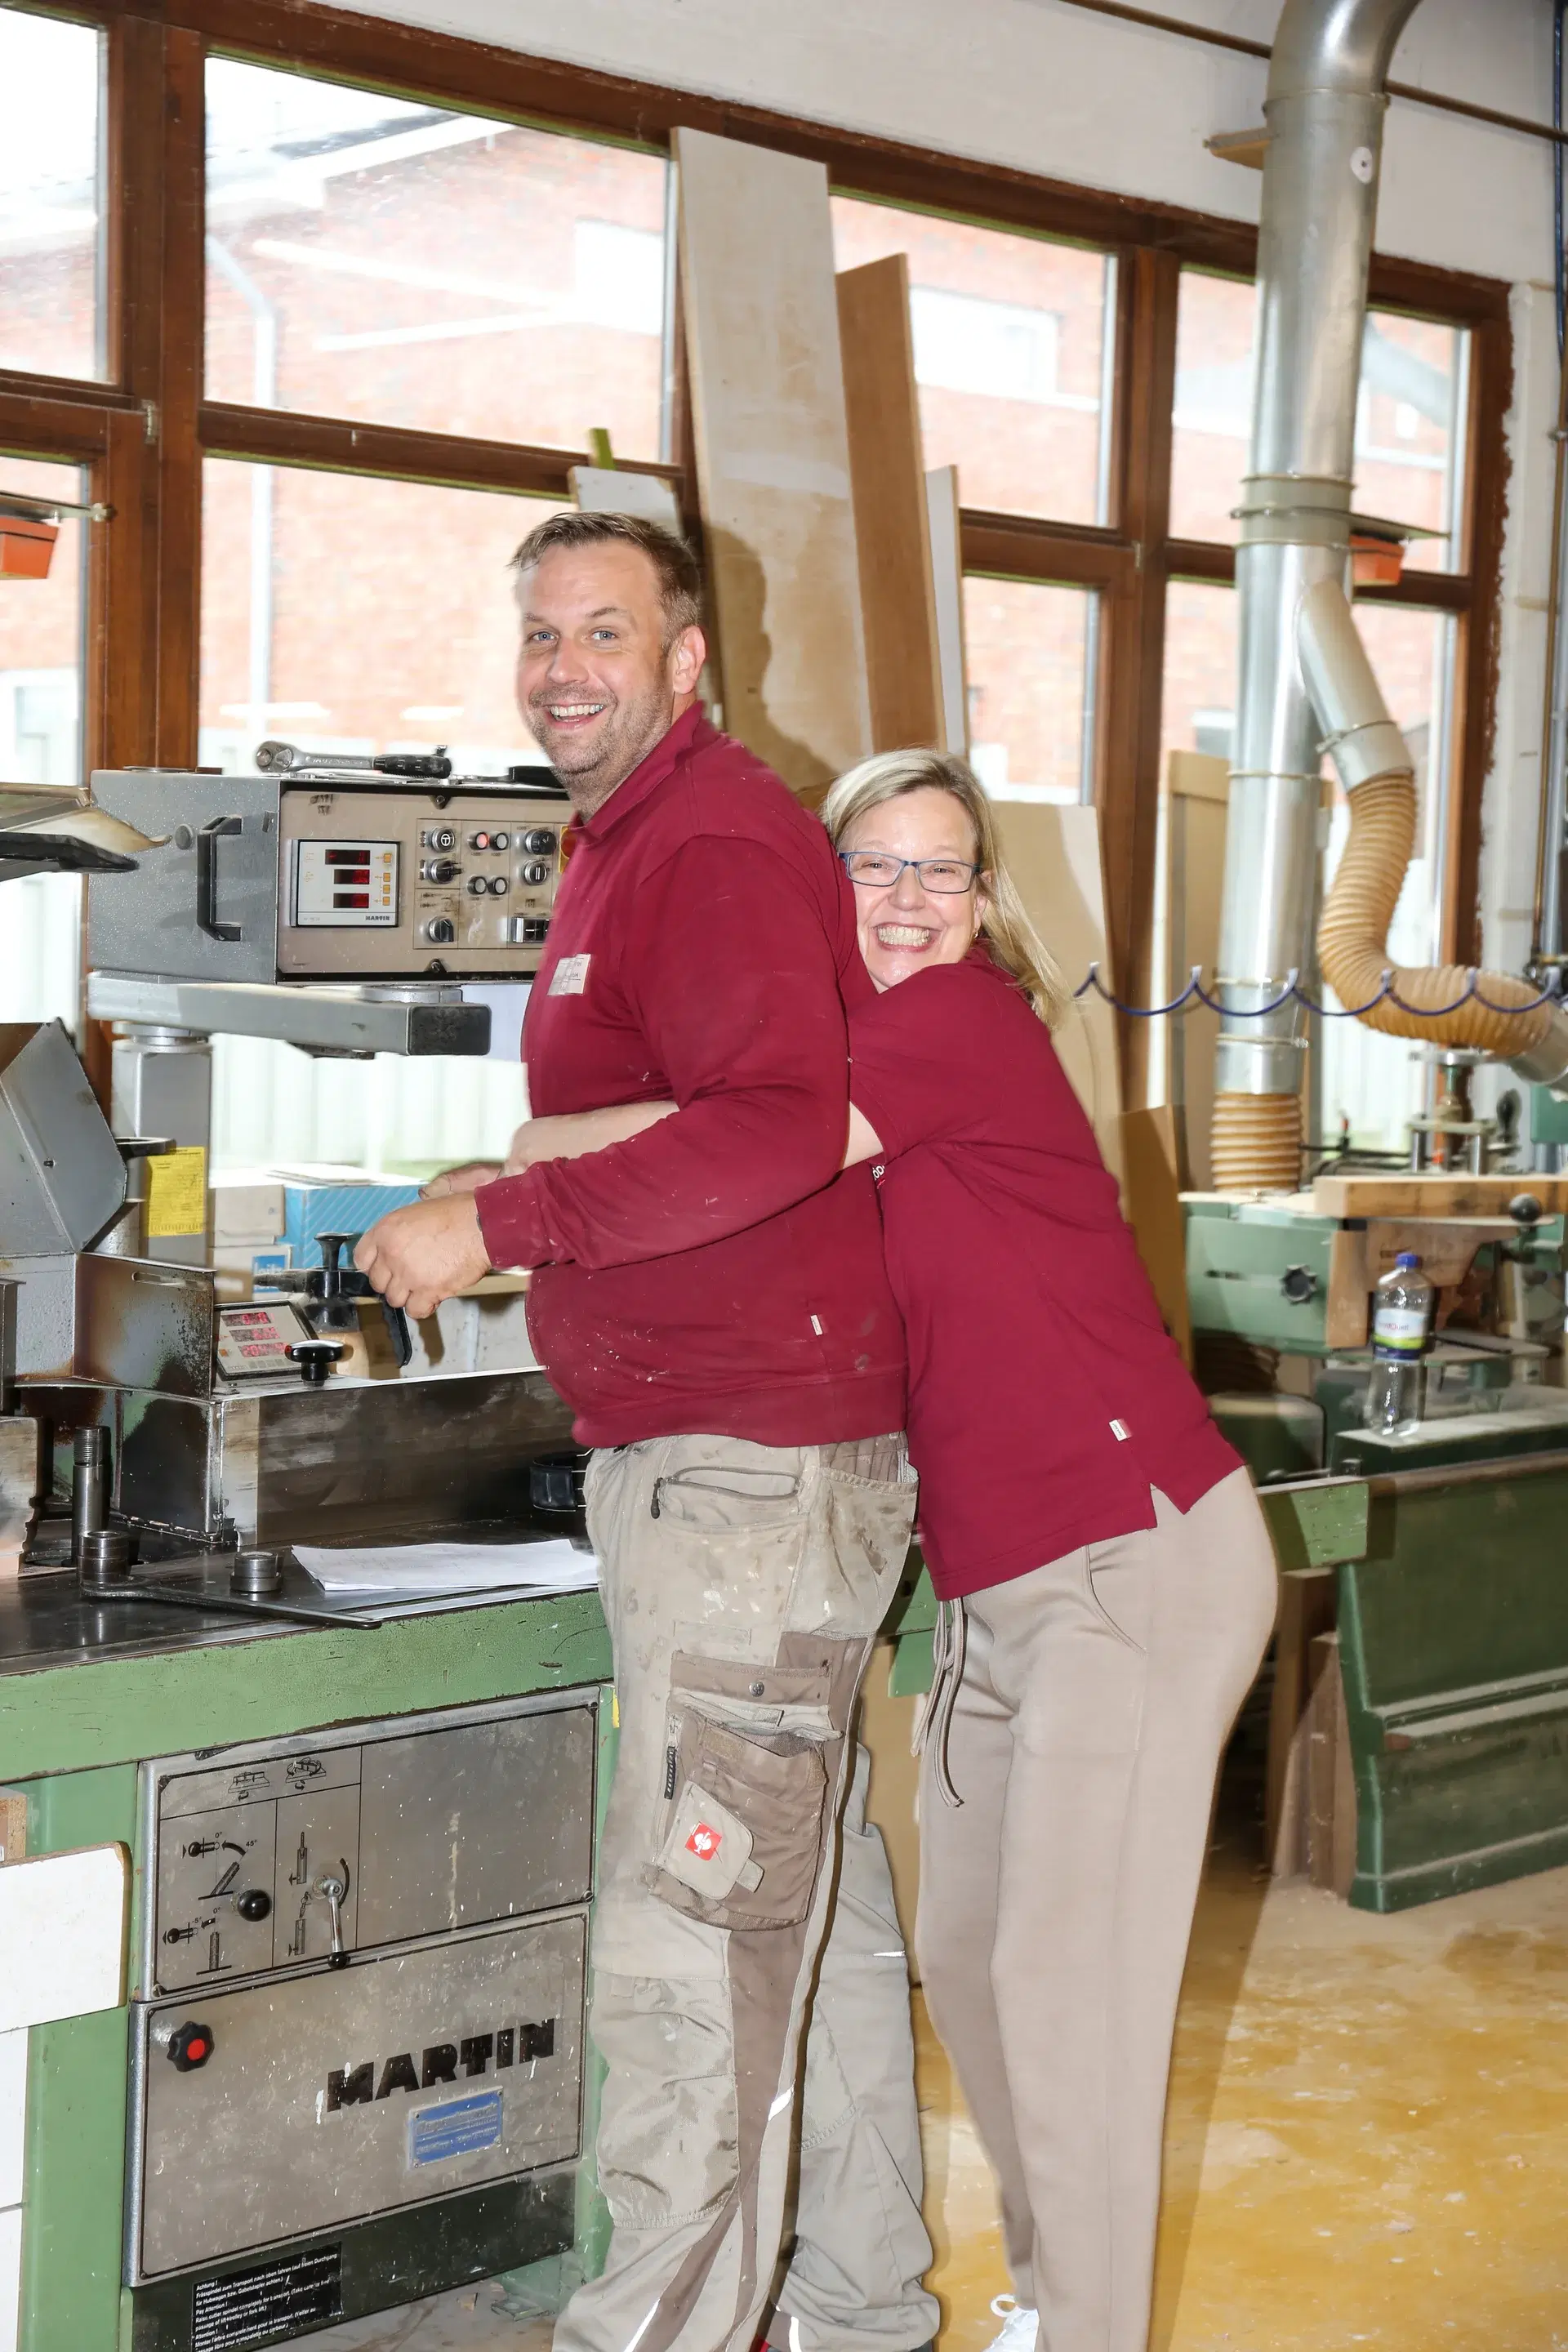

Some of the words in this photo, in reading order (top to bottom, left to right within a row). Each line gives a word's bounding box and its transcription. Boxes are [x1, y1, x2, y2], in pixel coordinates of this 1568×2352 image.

[327, 2018, 555, 2113] MARTIN
[233, 2278, 253, 2287] Transport
[278, 2267, 292, 2275] fahren
[314, 2253, 337, 2264] Durchgang
[203, 2294, 227, 2305] Hubwagen
[238, 2283, 265, 2294] Gabelstapler
[205, 2303, 225, 2313] Attention
[239, 2300, 262, 2310] completely
[195, 2330, 216, 2340] Attention
[195, 2339, 212, 2348] Monter
